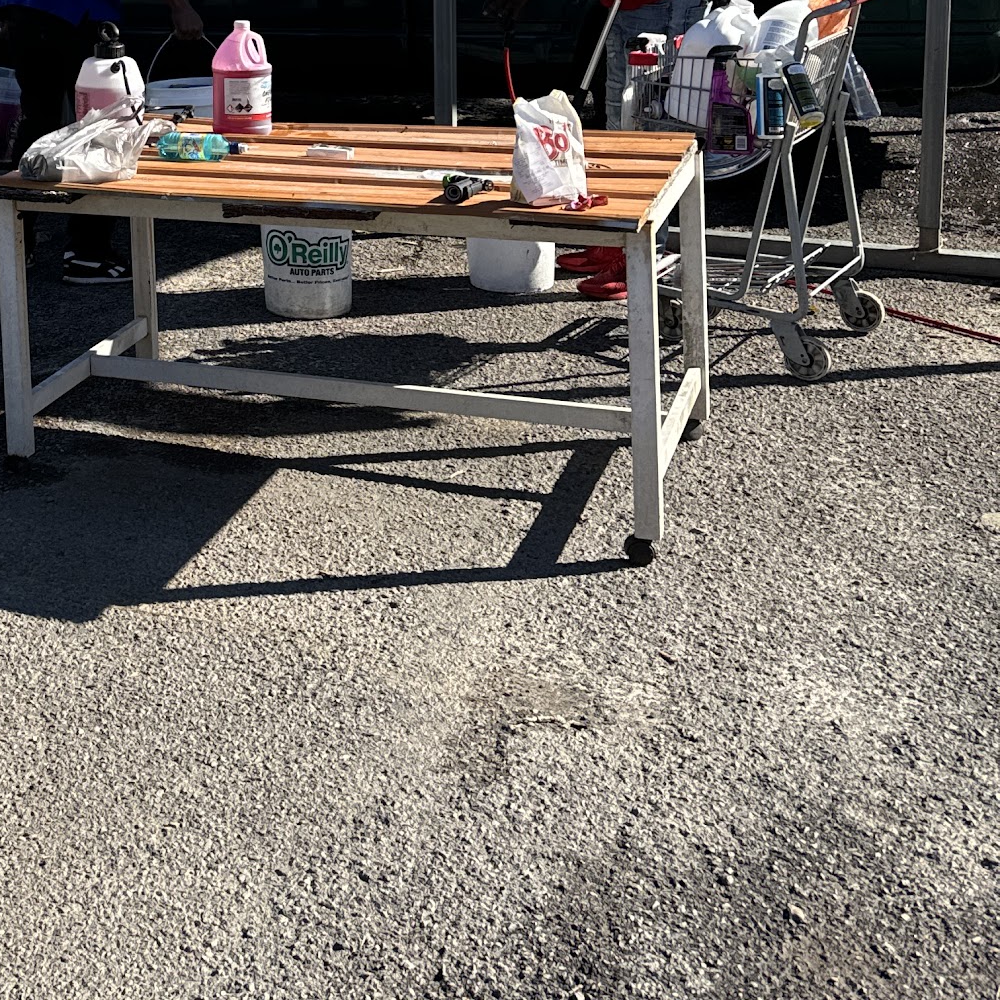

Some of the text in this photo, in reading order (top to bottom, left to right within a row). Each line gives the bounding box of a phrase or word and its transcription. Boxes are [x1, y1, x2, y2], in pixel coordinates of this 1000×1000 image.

[267, 231, 349, 269] O'Reilly
[290, 268, 334, 276] AUTO PARTS
